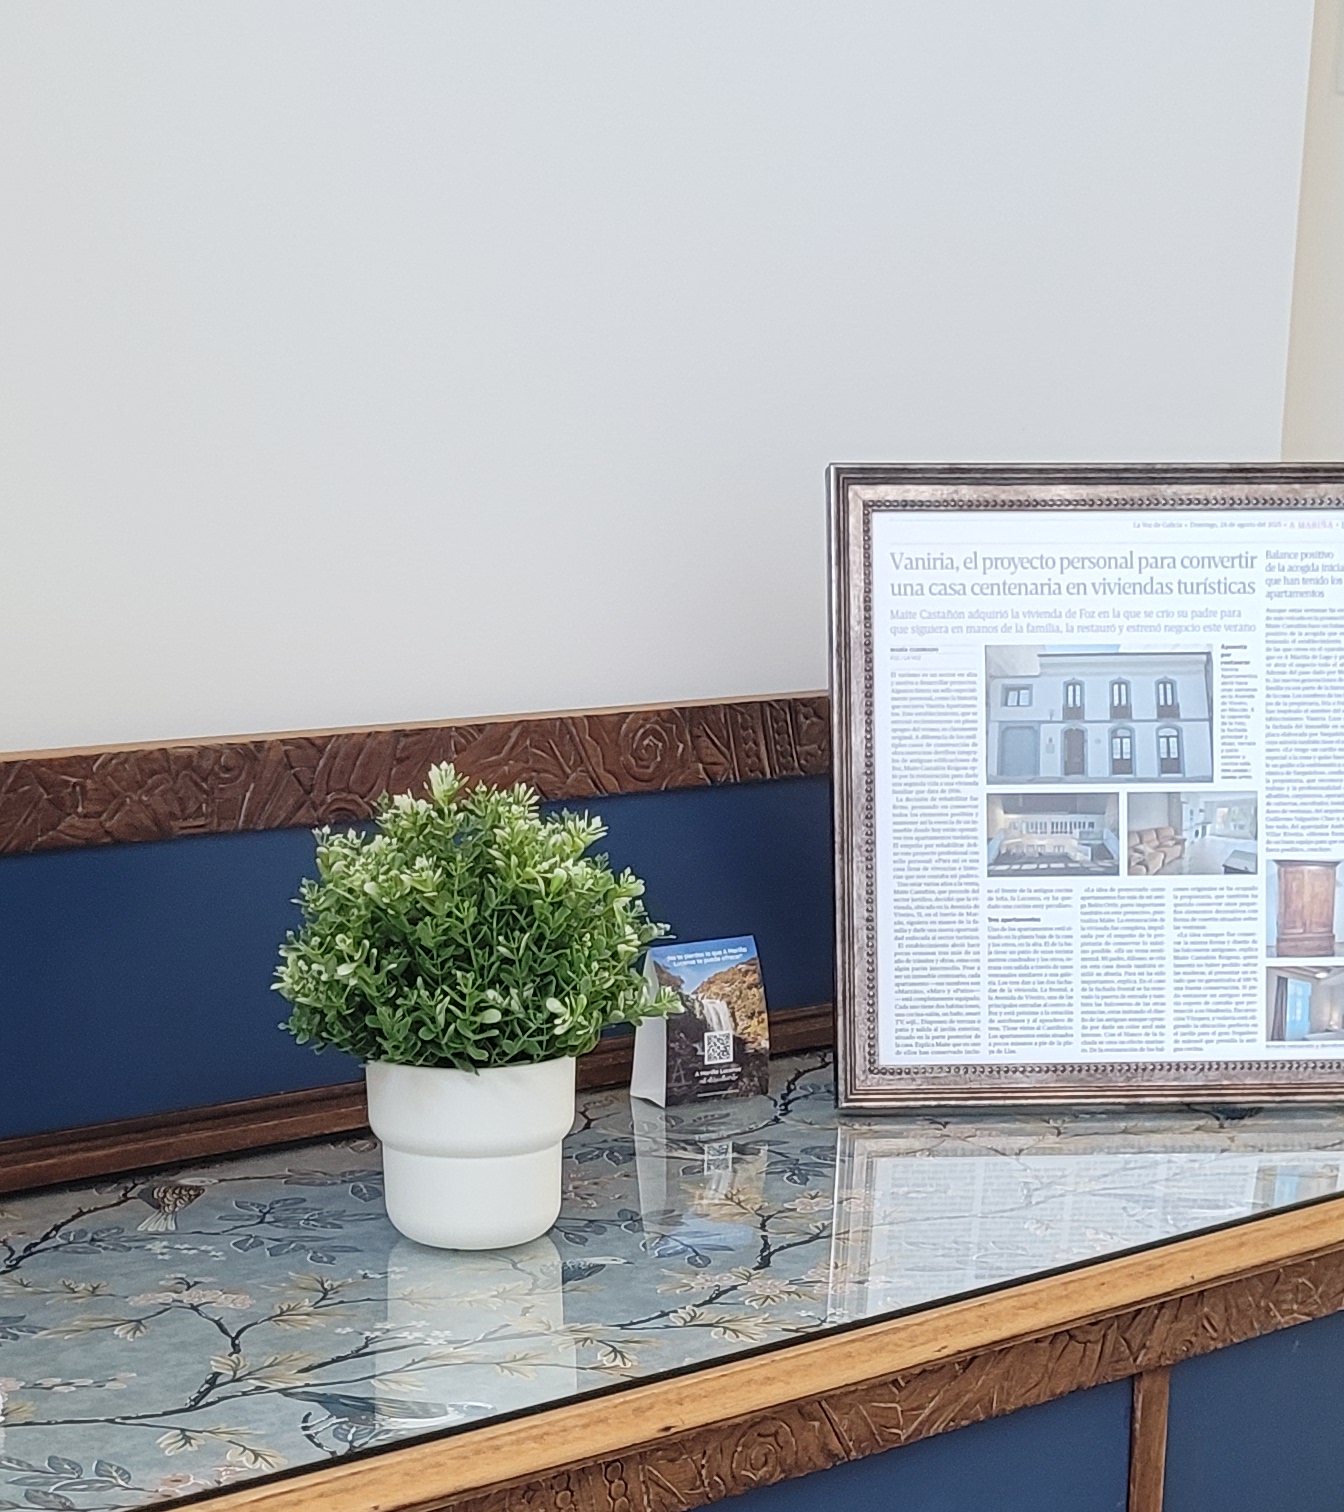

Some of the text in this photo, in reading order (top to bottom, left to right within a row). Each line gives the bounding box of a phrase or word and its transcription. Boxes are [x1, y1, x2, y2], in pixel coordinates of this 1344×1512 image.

[1266, 550, 1334, 561] Balance positivo
[890, 551, 1258, 574] Vaniria, el proyecto personal para convertir
[1265, 562, 1276, 572] de
[1278, 562, 1285, 572] la
[1287, 562, 1319, 574] acogida
[890, 577, 1255, 596] una casa centenaria en viviendas turísticas
[1265, 576, 1342, 587] que han tenido los
[1265, 590, 1324, 600] apartamentos
[890, 610, 917, 620] Maite
[920, 609, 965, 620] Castañón
[968, 609, 1008, 621] adquirió
[1011, 608, 1019, 619] la
[1022, 608, 1062, 619] vivienda
[1065, 608, 1076, 619] de
[1080, 608, 1096, 619] Foz
[1098, 610, 1110, 619] en
[1112, 608, 1120, 618] la
[1123, 610, 1141, 620] que
[1144, 610, 1154, 618] se
[1177, 610, 1188, 618] su
[1191, 608, 1218, 620] padre
[1220, 609, 1241, 620] para
[890, 622, 1256, 636] que siguiera en manos de la familia, la restauró y estrenó negocio este verano
